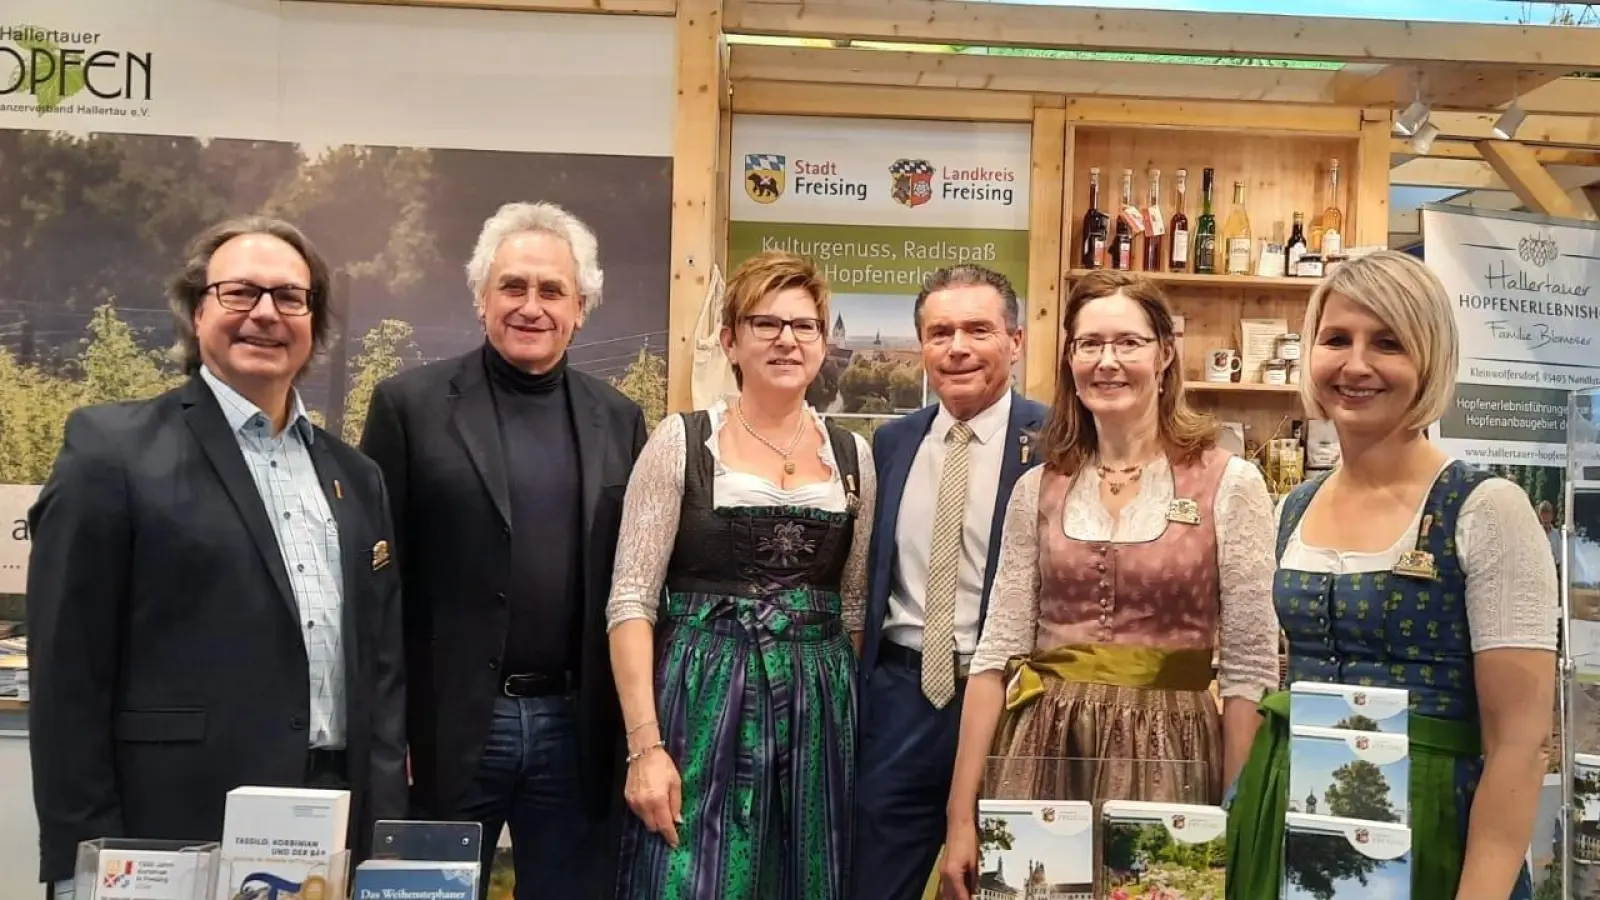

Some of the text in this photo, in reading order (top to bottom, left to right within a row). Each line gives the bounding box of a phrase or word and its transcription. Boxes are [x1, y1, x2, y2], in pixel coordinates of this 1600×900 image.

[0, 26, 101, 44] Hallertauer
[77, 105, 127, 117] Hallertau
[130, 107, 151, 118] e.V.
[795, 159, 837, 176] Stadt
[942, 165, 1015, 182] Landkreis
[795, 176, 868, 201] Freising
[942, 182, 1013, 206] Freising
[762, 236, 996, 264] Kulturgenuss, Radlspaß
[823, 264, 941, 287] Hopfenerle
[1484, 260, 1592, 296] Hallertauer
[1459, 294, 1600, 319] HOPFENERLEBNISH
[1484, 319, 1533, 342] Familie
[360, 888, 380, 900] Das
